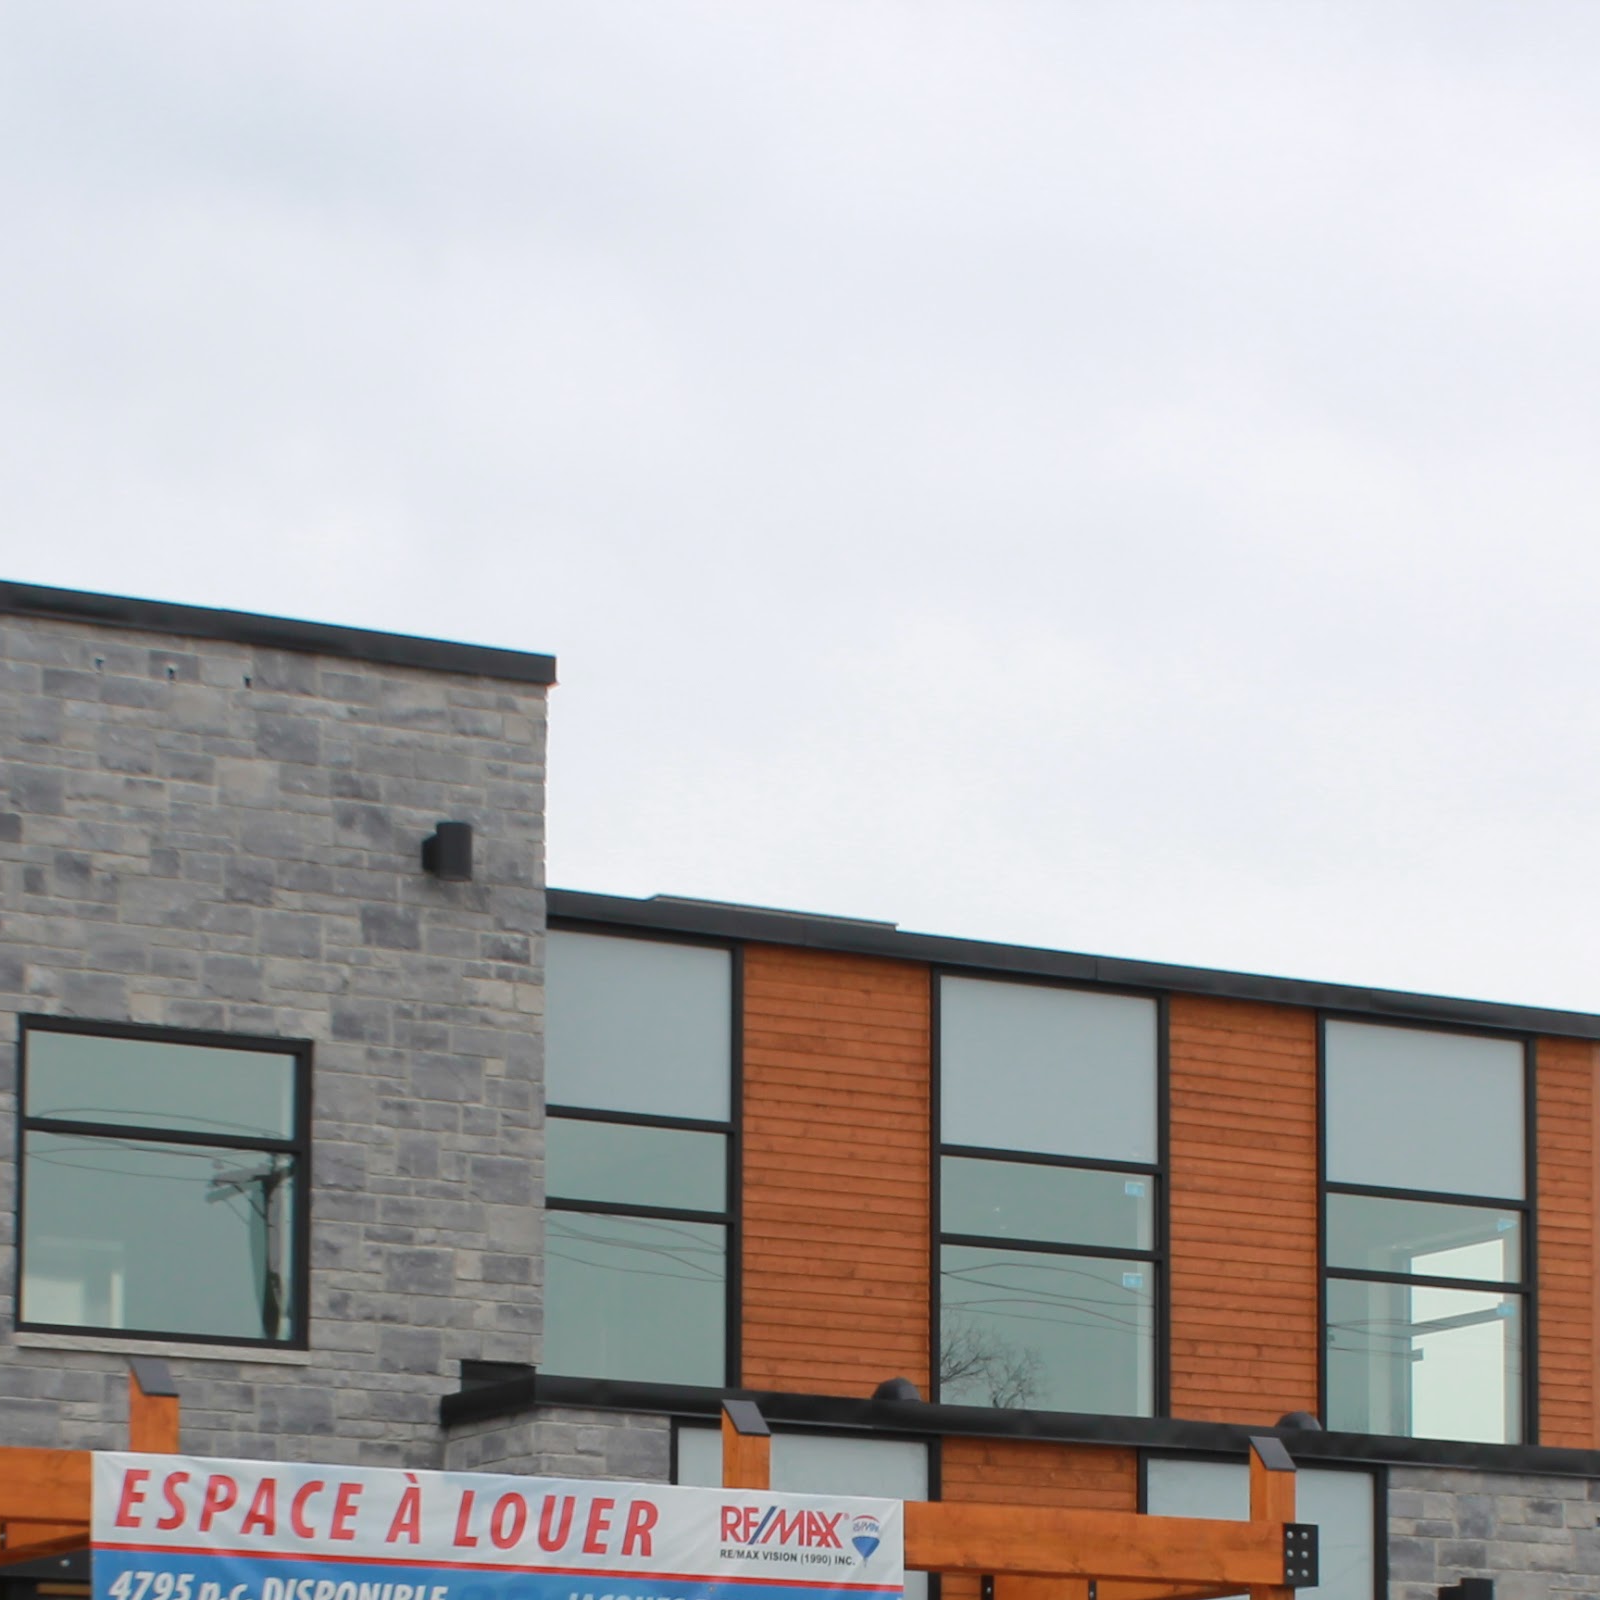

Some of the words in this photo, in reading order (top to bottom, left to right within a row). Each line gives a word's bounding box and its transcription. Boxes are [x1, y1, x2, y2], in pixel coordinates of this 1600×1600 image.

[114, 1468, 364, 1542] ESPACE
[385, 1472, 421, 1545] À
[452, 1489, 660, 1557] LOUER
[720, 1505, 844, 1549] RE/MAX
[720, 1549, 759, 1560] RE/MAX
[763, 1552, 798, 1562] VISION
[800, 1553, 832, 1566] (1990)
[834, 1556, 856, 1567] INC.
